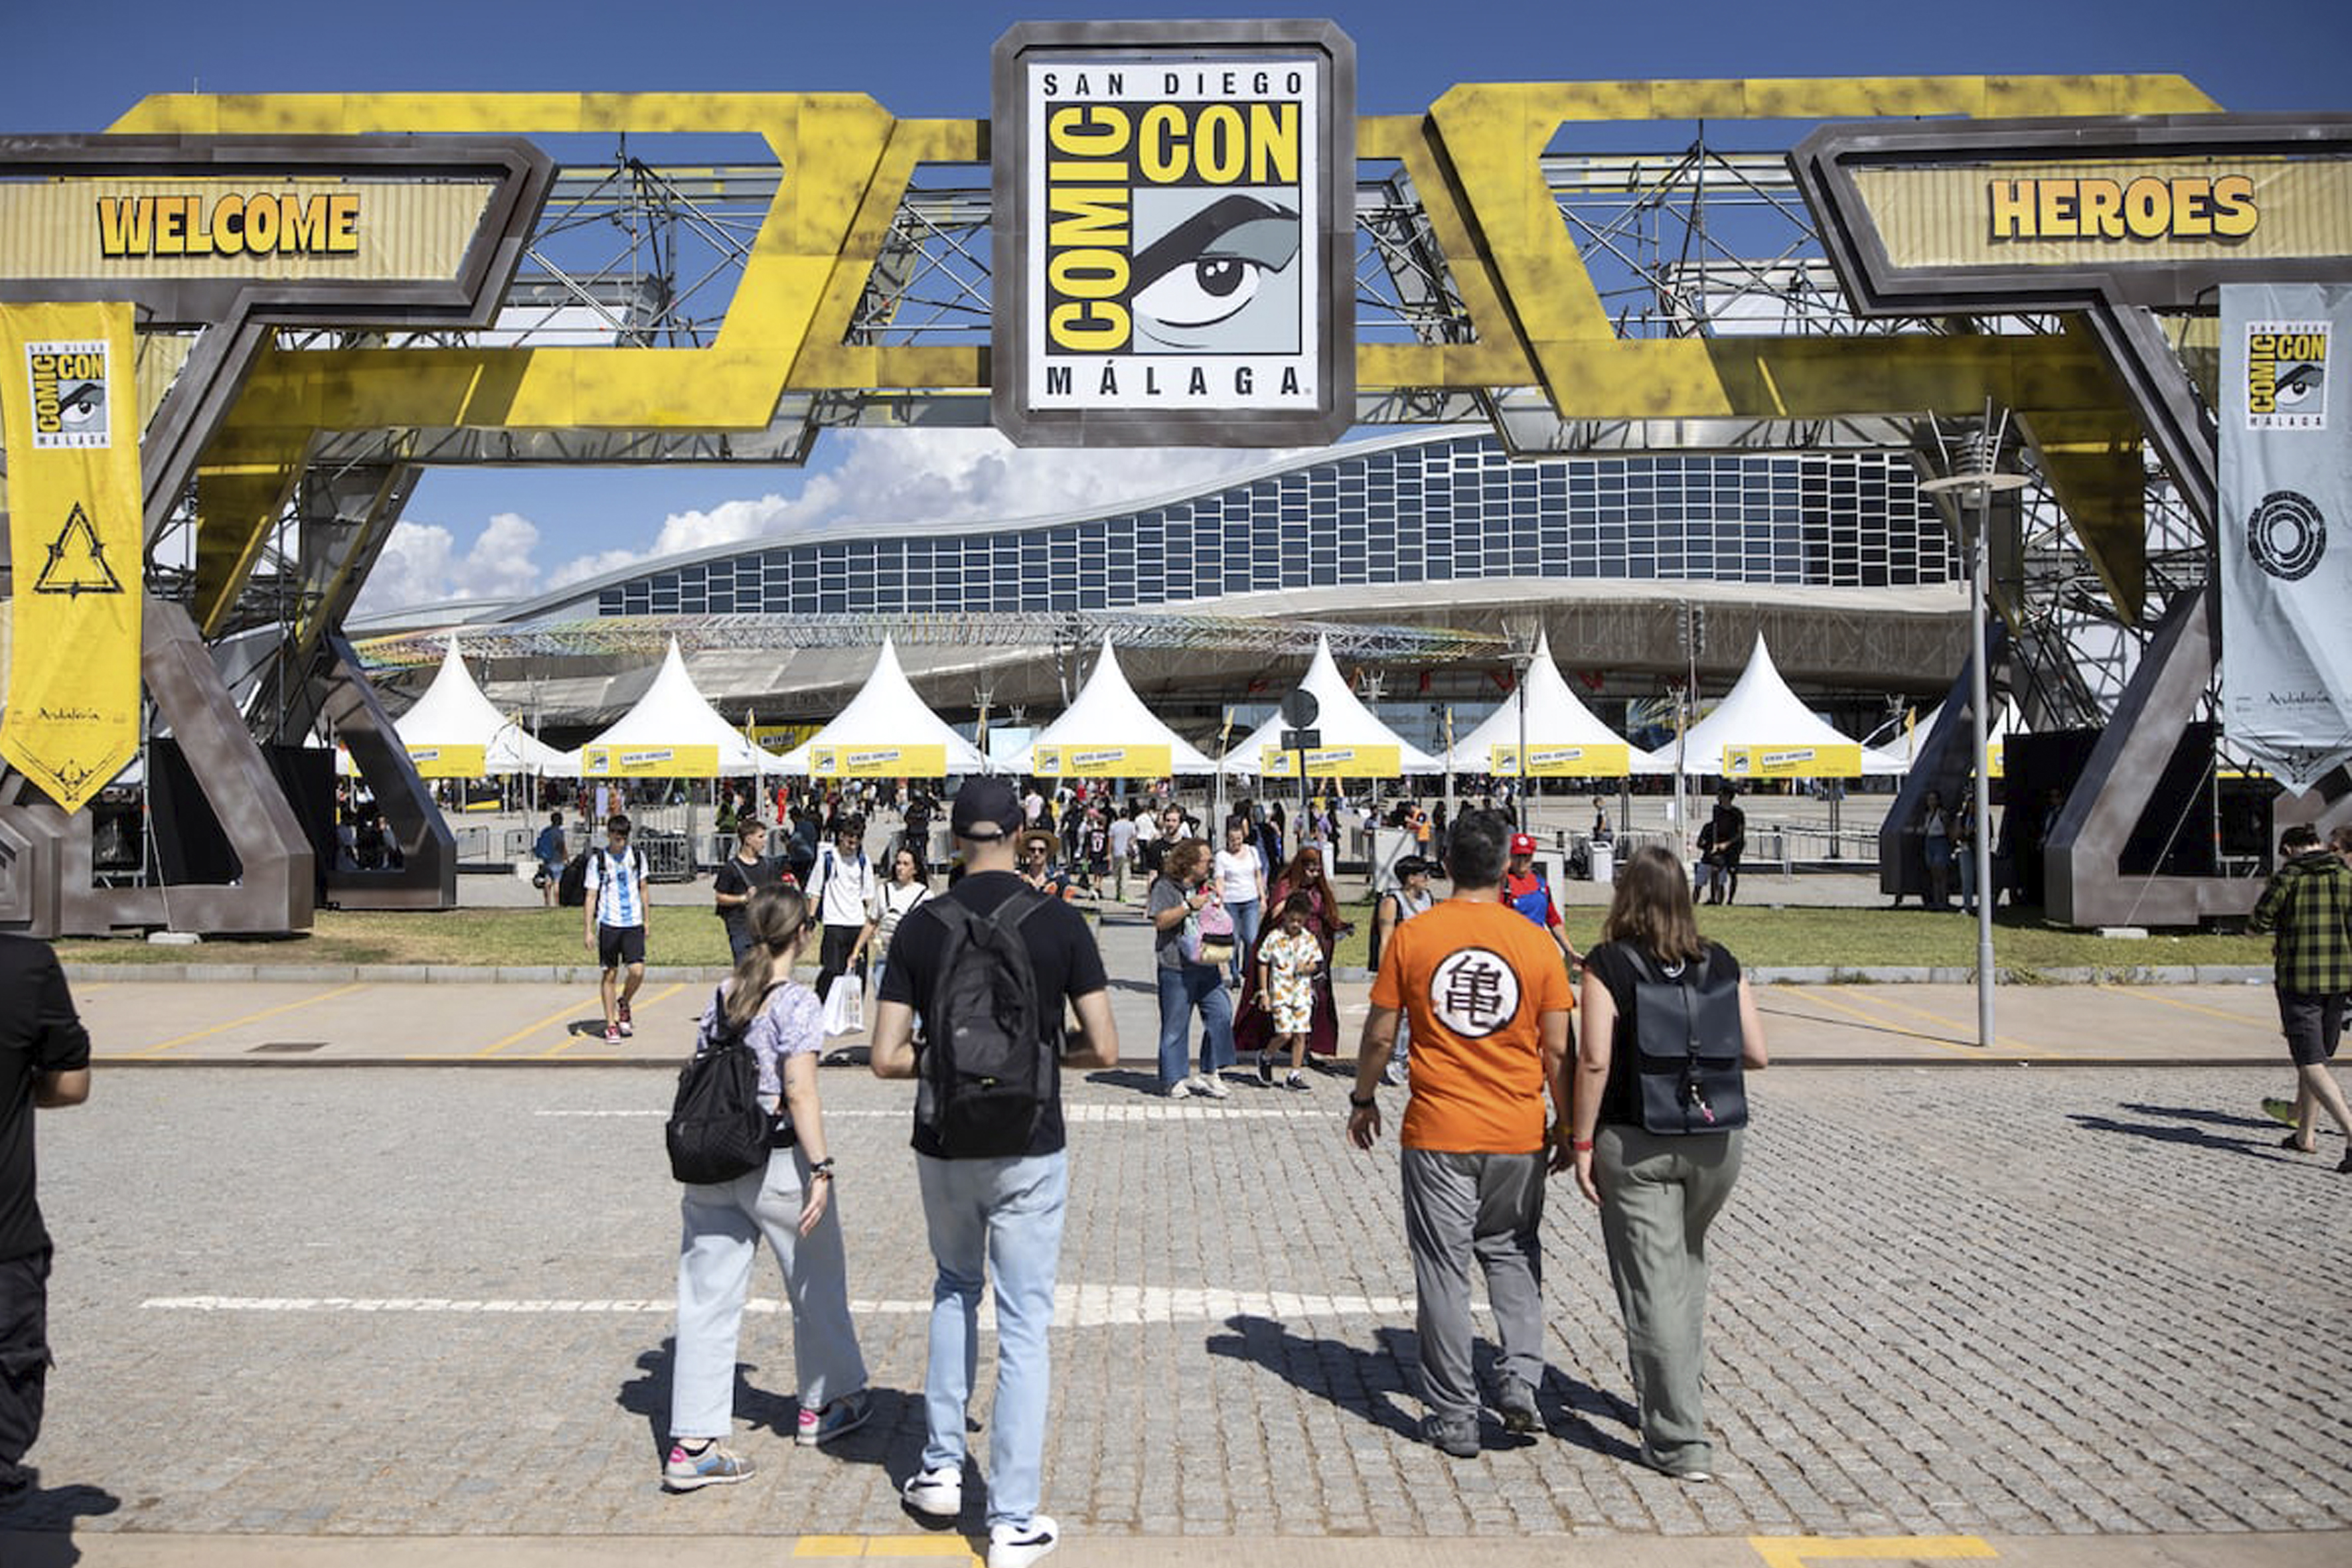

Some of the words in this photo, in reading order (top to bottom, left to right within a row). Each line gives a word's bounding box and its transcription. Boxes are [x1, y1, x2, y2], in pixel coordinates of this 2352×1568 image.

[1044, 72, 1123, 96] SAN
[1164, 72, 1302, 96] DIEGO
[1138, 104, 1299, 183] CON
[97, 193, 360, 258] WELCOME
[1049, 105, 1132, 353] COMIC
[1988, 175, 2258, 246] HEROES
[58, 354, 104, 380] CON
[1046, 360, 1299, 395] MÁLAGA
[2250, 335, 2276, 413] COMIC
[2277, 335, 2325, 360] CON
[33, 355, 62, 431] COMIC
